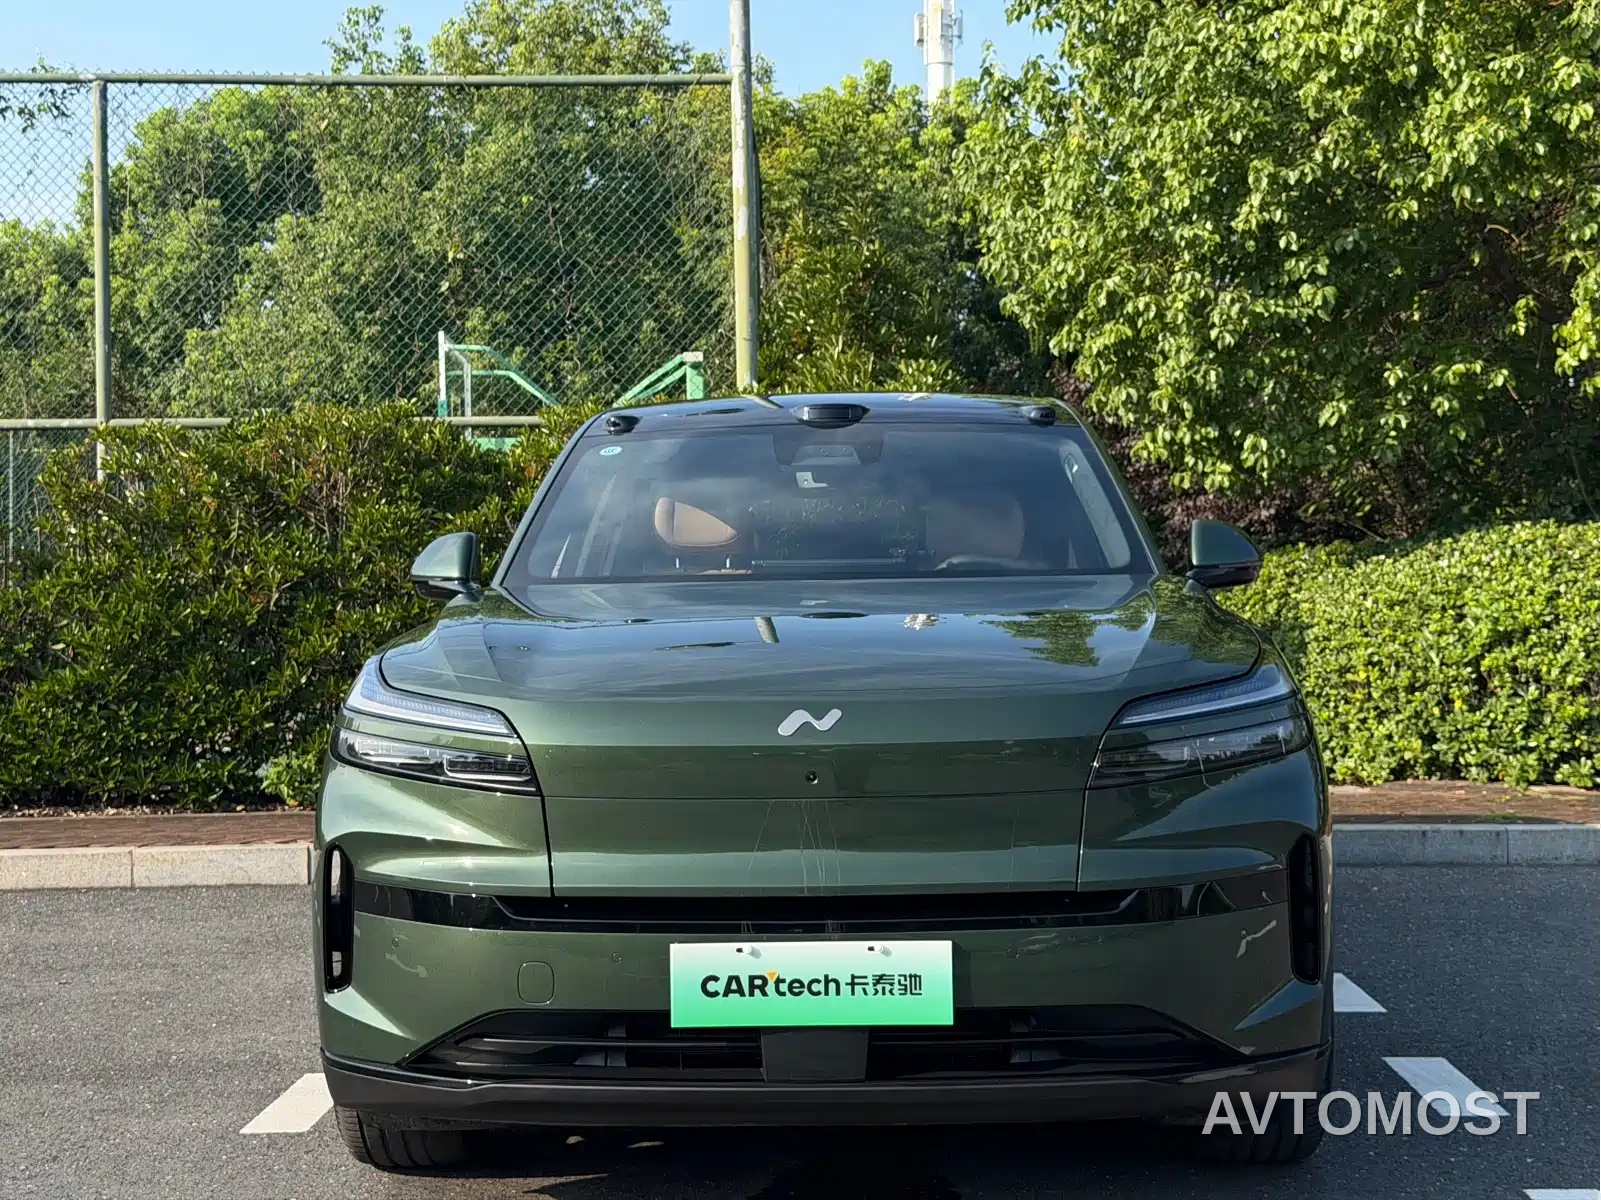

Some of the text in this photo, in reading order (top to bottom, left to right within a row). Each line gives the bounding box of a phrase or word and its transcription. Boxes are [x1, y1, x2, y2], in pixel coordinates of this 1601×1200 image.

[700, 972, 923, 998] CARtech 卡泰驰
